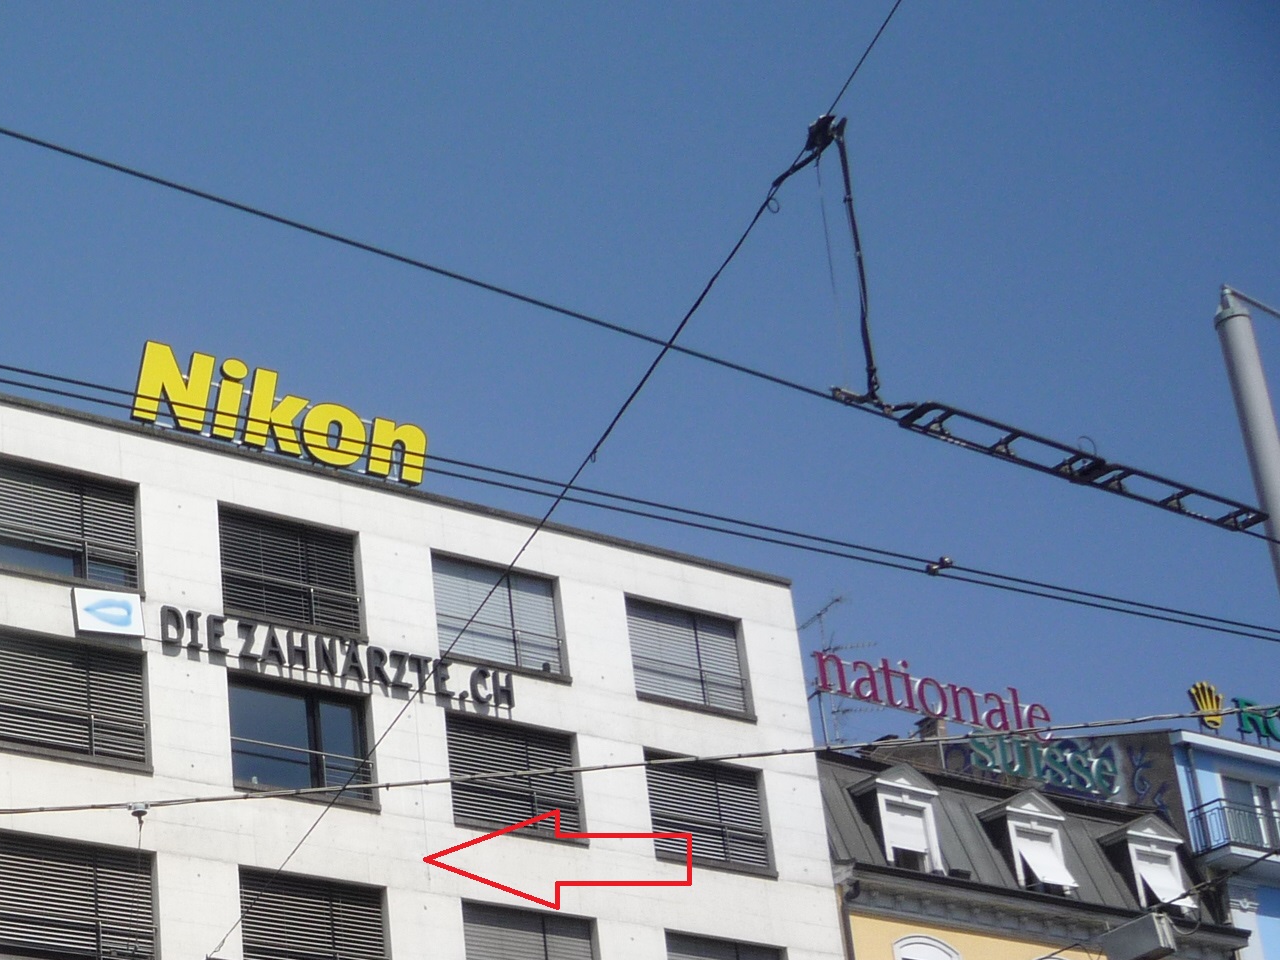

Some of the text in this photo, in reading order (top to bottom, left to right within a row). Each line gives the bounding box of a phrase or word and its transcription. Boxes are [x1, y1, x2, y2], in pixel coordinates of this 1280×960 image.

[131, 340, 428, 486] Nikon
[160, 605, 229, 653] DIE
[812, 650, 1056, 744] nationale
[968, 726, 1122, 797] suisse
